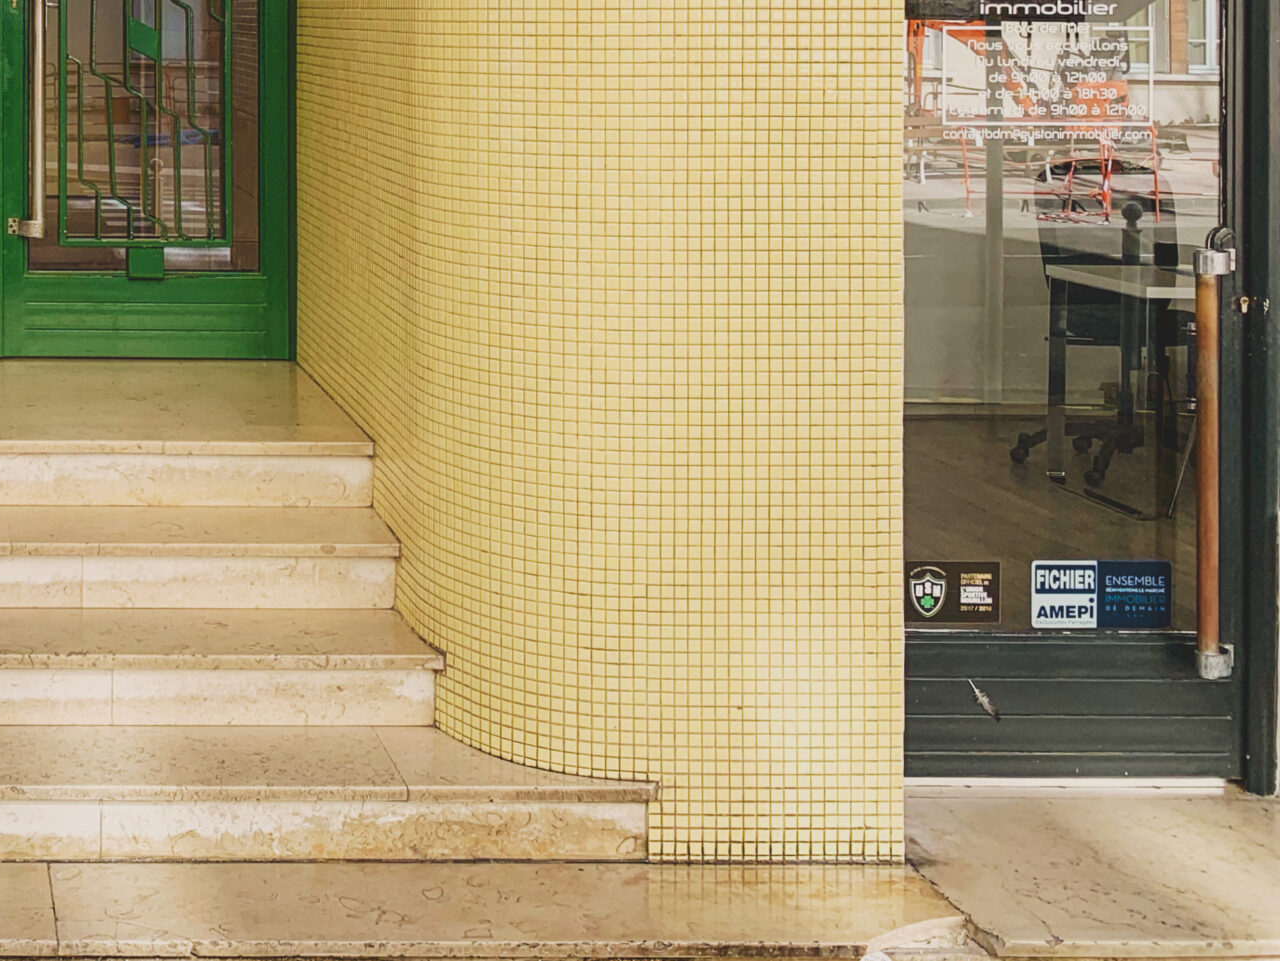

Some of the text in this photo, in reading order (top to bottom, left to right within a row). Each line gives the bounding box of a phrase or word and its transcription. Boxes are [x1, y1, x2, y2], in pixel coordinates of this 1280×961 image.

[979, 0, 1117, 15] immobilier
[1040, 23, 1058, 34] de
[968, 40, 1003, 51] Nous
[989, 72, 1006, 83] de
[1011, 72, 1049, 83] 9h00
[1065, 72, 1106, 83] 12h00
[995, 88, 1013, 100] de
[1063, 87, 1072, 99] à
[1077, 88, 1116, 100] 18h30
[1029, 104, 1046, 116] de
[1050, 104, 1087, 116] 9h00
[1091, 103, 1100, 116] à
[1105, 104, 1146, 116] 12h00
[1036, 569, 1095, 590] FICHIER
[1105, 575, 1165, 587] ENSEMBLE
[1105, 594, 1165, 604] IMMOBILIER
